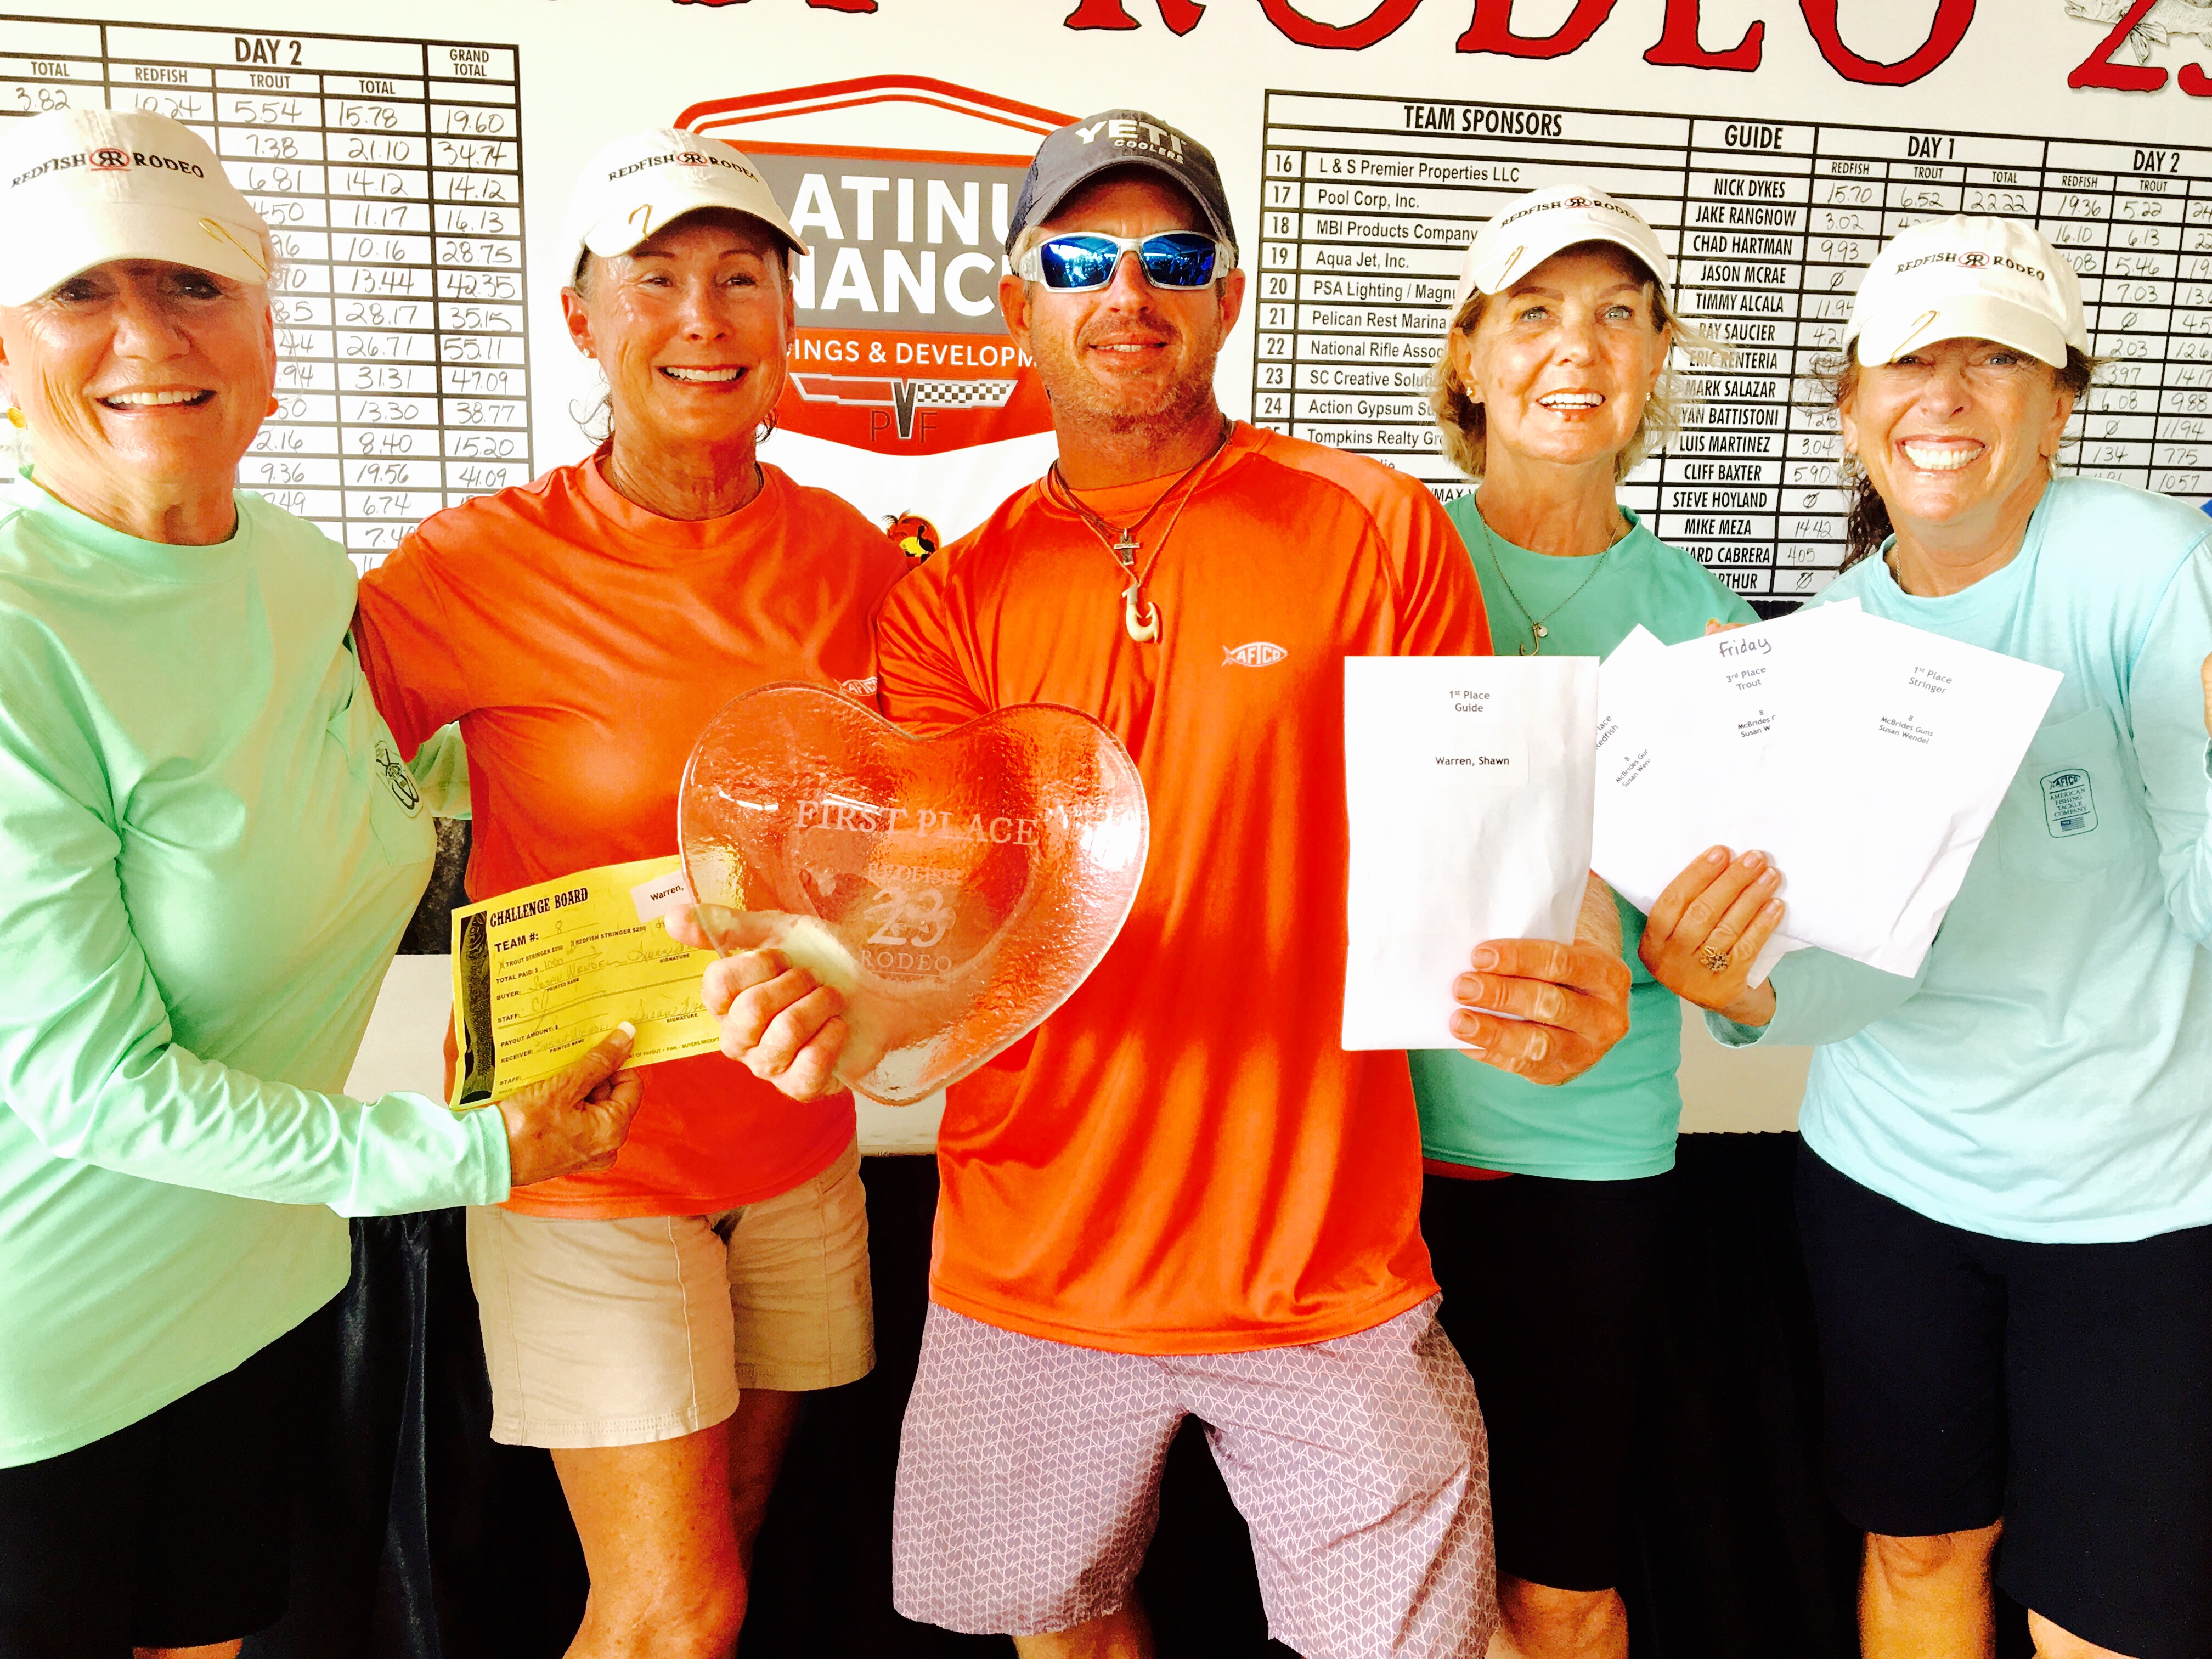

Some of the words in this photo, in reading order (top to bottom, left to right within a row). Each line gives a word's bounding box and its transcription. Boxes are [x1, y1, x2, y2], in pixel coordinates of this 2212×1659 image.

[235, 37, 281, 64] DAY
[289, 40, 302, 66] 2
[450, 49, 489, 63] GRAND
[31, 61, 70, 77] TOTAL
[135, 67, 188, 83] REDFISH
[454, 63, 487, 76] TOTAL
[250, 74, 290, 89] TROUT
[359, 80, 396, 94] TOTAL
[15, 87, 71, 111] 3.82
[445, 109, 504, 134] 19.60
[1404, 105, 1454, 130] TEAM
[1462, 109, 1562, 136] SPONSORS
[1075, 119, 1183, 155] YETI
[1725, 125, 1783, 149] GUIDE
[348, 137, 410, 162] 21.10
[1114, 139, 1184, 165] COOLERS
[1908, 136, 1942, 158] DAY
[1948, 138, 1955, 159] 1
[12, 153, 87, 188] REDFISH
[133, 153, 204, 178] RODEO
[608, 154, 674, 182] REDFISH
[1276, 155, 1292, 172] 16
[1320, 157, 1328, 172] L
[1333, 159, 1342, 173] &
[1347, 159, 1356, 174] S
[1361, 160, 1414, 177] Premier
[1419, 163, 1488, 182] Properties
[1493, 167, 1520, 182] LLC
[1832, 162, 1869, 174] REDFISH
[2133, 150, 2166, 172] DAY
[2170, 153, 2180, 173] 2
[1914, 167, 1943, 179] TROUT
[1993, 171, 2017, 183] TOTAL
[2062, 176, 2097, 188] REDFISH
[449, 176, 506, 202] 14.12
[1274, 186, 1291, 203] 17
[1714, 178, 1745, 196] NICK
[1748, 180, 1785, 198] DYKES
[2140, 180, 2168, 192] TROUT
[1318, 189, 1349, 205] Pool
[1354, 190, 1390, 210] Corp,
[1396, 193, 1419, 208] Inc.
[1500, 201, 1561, 228] REDFISH
[1696, 206, 1725, 223] JAKE
[1729, 207, 1796, 226] RANGNOW
[1273, 216, 1289, 234] 18
[1317, 220, 1342, 235] MBI
[1348, 221, 1409, 238] Products
[1414, 224, 1478, 244] Company
[348, 236, 405, 262] 10.16
[442, 240, 512, 264] 28.75
[1694, 235, 1727, 252] CHAD
[1732, 236, 1792, 255] HARTMAN
[1272, 247, 1288, 264] 19
[1316, 250, 1351, 269] Aqua
[1356, 252, 1380, 269] Jet,
[1385, 253, 1408, 268] Inc.
[1701, 265, 1740, 282] JASON
[1745, 267, 1786, 283] MCRAE
[1895, 253, 1957, 274] REDFISH
[1994, 256, 2044, 281] RODEO
[1269, 277, 1287, 295] 20
[1314, 280, 1342, 295] PSA
[1347, 281, 1402, 301] Lighting
[1696, 293, 1737, 310] TIMMY
[1740, 295, 1783, 312] ALCALA
[1269, 307, 1285, 325] 21
[1313, 310, 1362, 326] Pelican
[1367, 312, 1397, 328] Rest
[1402, 313, 1446, 329] Marina
[1725, 324, 1775, 341] SAUCIER
[787, 338, 860, 363] INGS
[868, 342, 887, 363] &
[1267, 337, 1284, 354] 22
[1311, 340, 1365, 356] National
[1370, 342, 1399, 357] Rifle
[1721, 352, 1777, 369] RENTERIA
[1266, 368, 1283, 385] 23
[1310, 370, 1329, 385] SC
[1334, 371, 1389, 387] Creative
[1724, 381, 1776, 397] SALAZAR
[456, 402, 515, 424] 38.77
[1265, 397, 1282, 414] 24
[1308, 399, 1352, 414] Action
[1358, 400, 1413, 418] Gypsum
[1709, 408, 1778, 425] BATTISTONI
[454, 436, 514, 458] 15.20
[1307, 428, 1374, 446] Tompkins
[1378, 430, 1419, 448] Realty
[1680, 436, 1705, 452] LUIS
[1709, 436, 1770, 452] MARTINEZ
[1684, 464, 1714, 480] CLIFF
[1719, 465, 1761, 481] BAXTER
[1673, 492, 1708, 507] STEVE
[1712, 492, 1767, 507] HOYLAND
[1685, 518, 1716, 534] MIKE
[1719, 520, 1751, 535] MEZA
[1718, 548, 1769, 563] CABRERA
[1719, 638, 1772, 658] Friday
[1726, 673, 1739, 682] 3rd
[1741, 668, 1766, 679] Place
[1909, 675, 1946, 693] Stringer
[1927, 670, 1952, 684] Place
[1736, 679, 1762, 690] Trout
[1449, 690, 1460, 698] 1st
[1464, 691, 1490, 699] Place
[1455, 703, 1483, 712] Guide
[1738, 717, 1770, 730] McBrides
[1741, 727, 1762, 737] Susan
[1881, 716, 1913, 731] McBrides
[1916, 727, 1933, 736] Guns
[1878, 725, 1899, 736] Susan
[1902, 731, 1929, 744] Wendel
[1435, 757, 1475, 766] Warren,
[1479, 757, 1509, 765] Shawn
[1616, 759, 1639, 783] McBrides
[1622, 772, 1638, 787] Susan
[797, 800, 909, 836] FIRST
[917, 809, 1040, 845] PLACE
[650, 885, 684, 901] Warren,
[490, 898, 550, 927] CHALLENGE
[554, 888, 588, 909] BOARD
[868, 888, 949, 946] 23
[494, 935, 526, 952] TEAM
[506, 957, 524, 967] TROUT
[526, 950, 550, 961] STRINGER
[575, 935, 599, 945] REDFISH
[600, 929, 631, 938] STRINGER
[860, 950, 952, 972] RODEO
[496, 975, 516, 984] TOTAL
